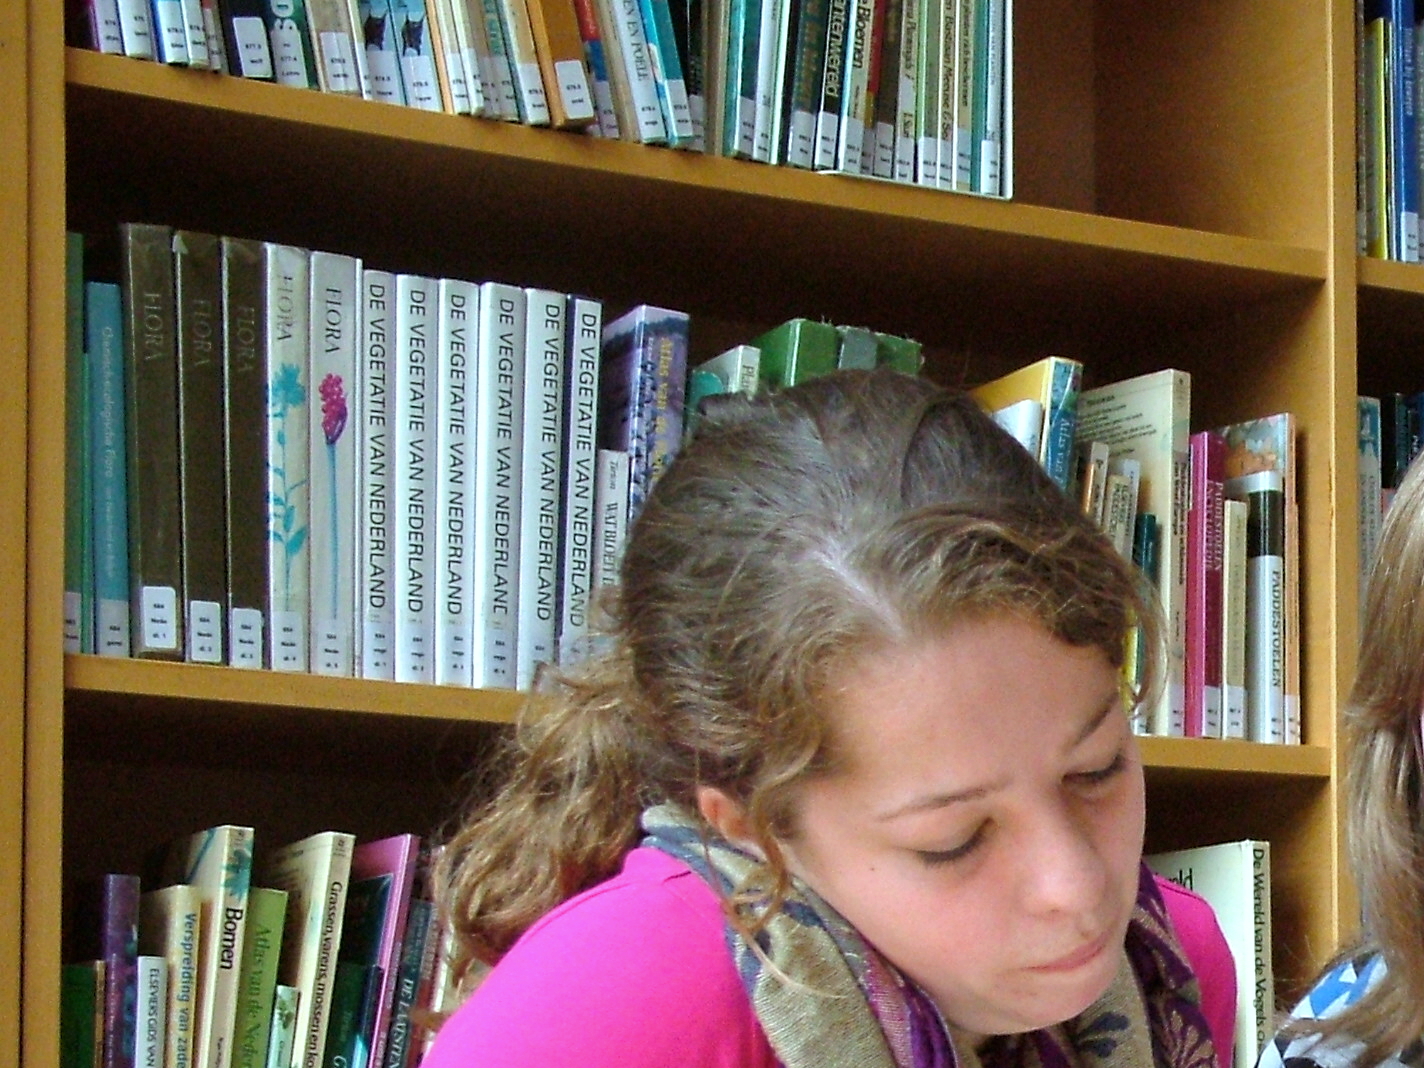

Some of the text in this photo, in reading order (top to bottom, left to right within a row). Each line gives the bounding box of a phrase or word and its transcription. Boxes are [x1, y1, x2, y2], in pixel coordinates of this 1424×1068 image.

[626, 21, 640, 39] EN
[853, 6, 871, 69] Bloemen
[631, 43, 651, 82] POELE
[143, 292, 164, 361] FLORA
[193, 300, 213, 367] FLORA
[276, 275, 295, 342] FLORA
[325, 287, 343, 354] FLORA
[499, 299, 514, 325] DE
[235, 307, 256, 372] FLORA
[499, 333, 515, 440] VEGETATIE
[369, 284, 386, 609] DE VEGETATIE VAN NEDERLAND
[408, 290, 426, 613] DE VEGETATIE VAN NEDERLAND
[447, 294, 466, 615] DE VEGETATIE VAN NEDERLAND
[496, 447, 512, 488] VAN
[536, 304, 561, 621] DE VEGETATIE VAN NEDERLAND
[570, 313, 598, 627] DE VEGETATIE VAN NEDERLAND
[1214, 482, 1224, 571] PADDESTOELEN
[1271, 571, 1282, 687] PADDESTOELEN
[1253, 849, 1265, 870] De
[1252, 872, 1266, 925] Wereld
[177, 912, 196, 1002] Verspreiding
[219, 907, 244, 970] Bomen
[252, 925, 273, 966] Atlas
[1253, 927, 1264, 953] van
[1254, 955, 1266, 972] de
[147, 969, 160, 1016] ELSEVIERS
[247, 969, 265, 997] van
[247, 1001, 267, 1018] de
[309, 982, 326, 1033] mossen
[402, 977, 417, 998] DE
[1253, 974, 1266, 1033] Vogels
[146, 1017, 158, 1042] GIDS
[178, 1008, 191, 1033] van
[309, 1034, 319, 1050] en
[145, 1045, 156, 1067] VAN
